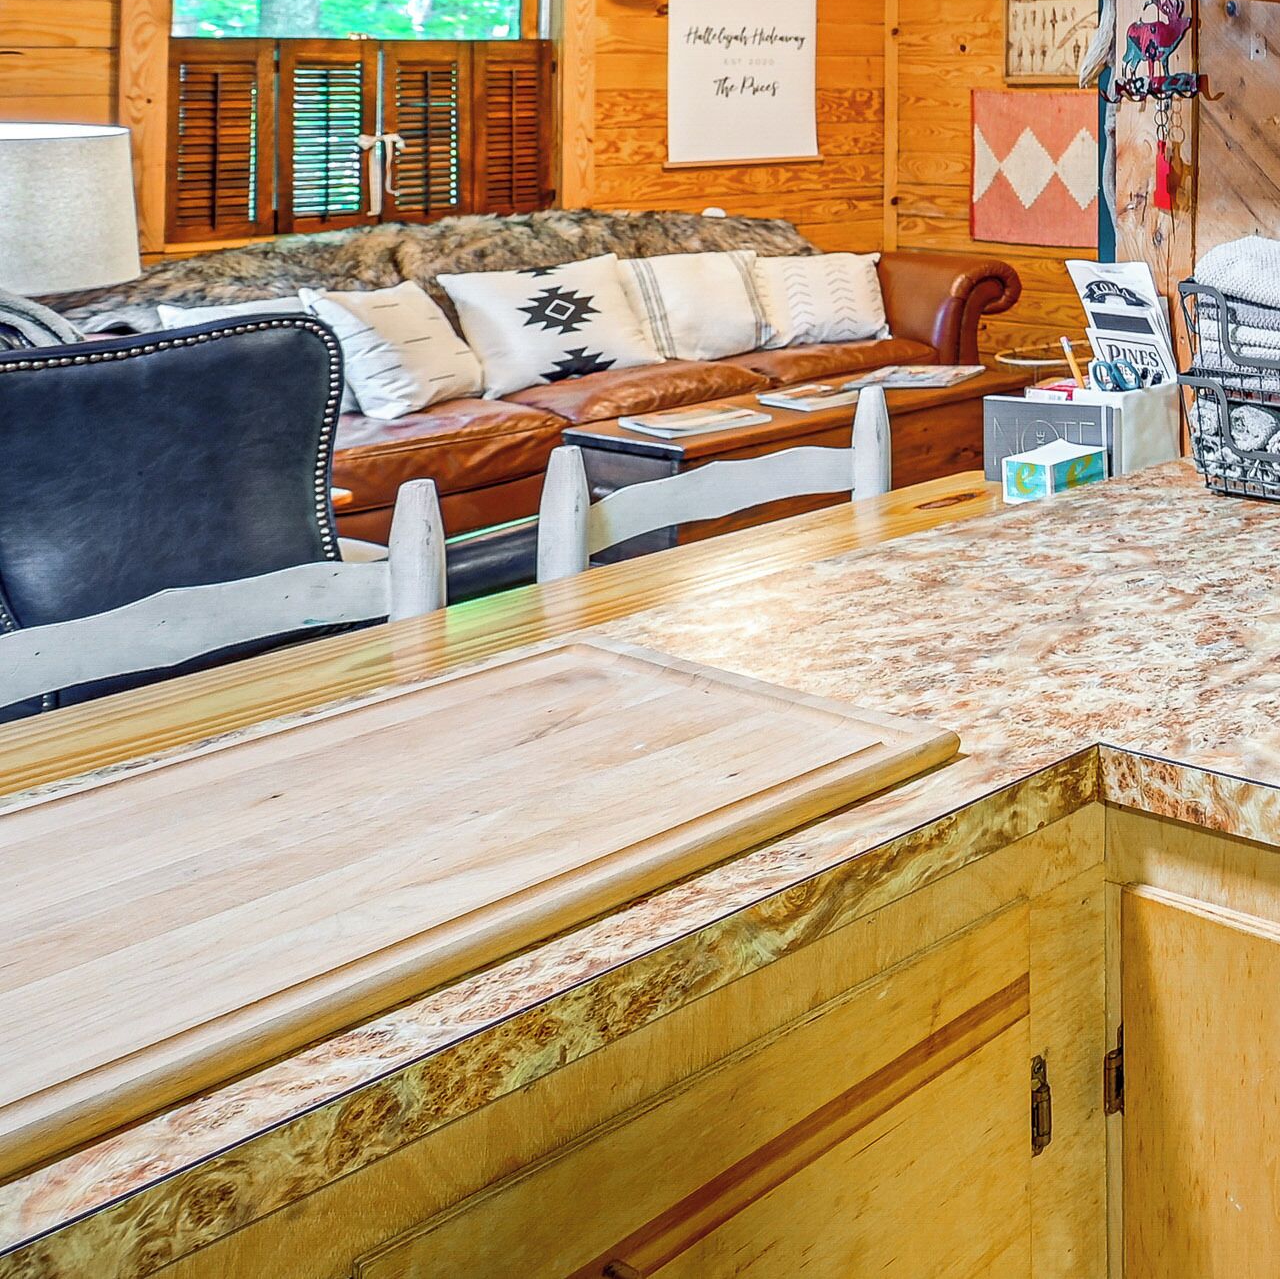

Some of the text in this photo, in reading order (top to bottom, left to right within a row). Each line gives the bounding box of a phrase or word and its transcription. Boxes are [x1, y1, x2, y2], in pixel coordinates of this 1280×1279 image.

[751, 26, 806, 50] Hideaway
[1093, 281, 1137, 302] ROMA
[1105, 343, 1160, 368] PINES
